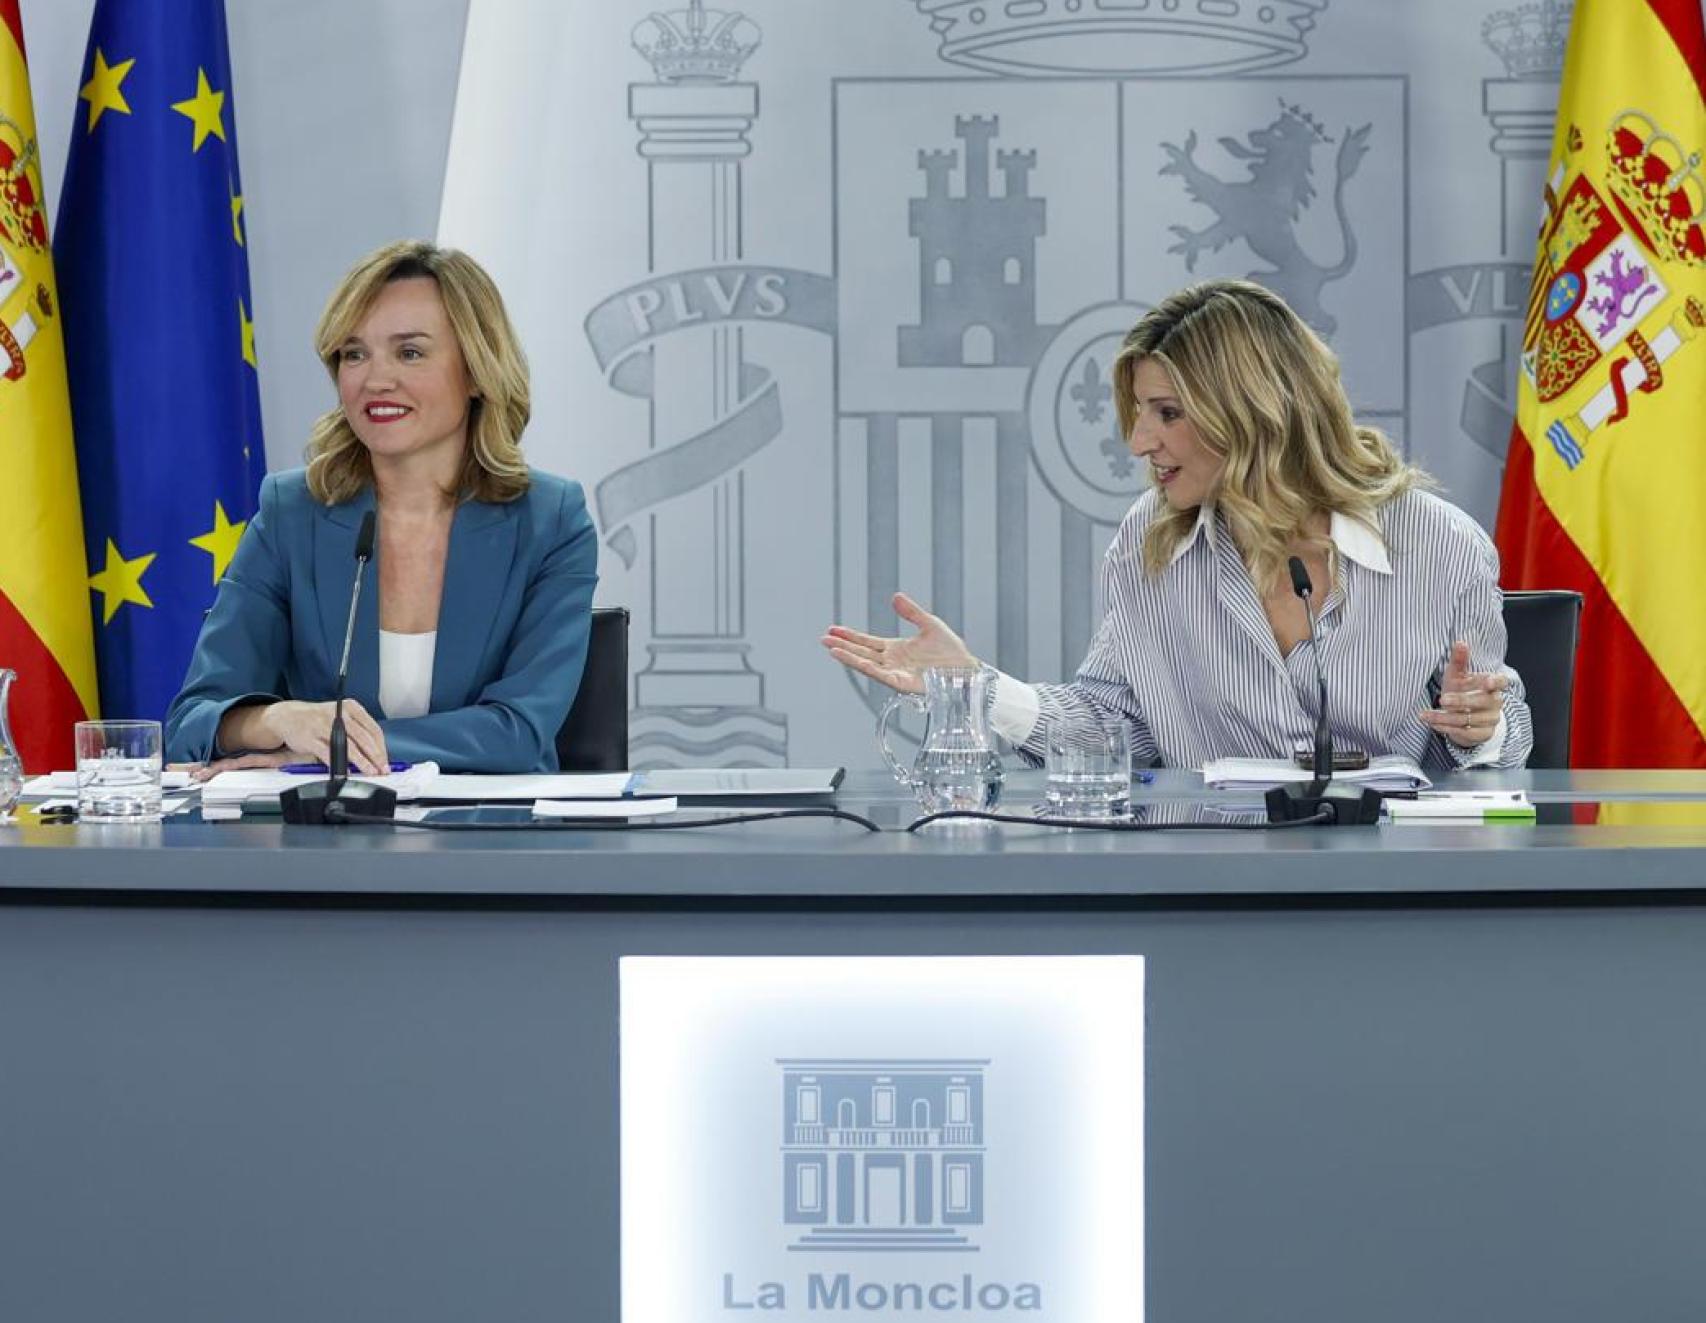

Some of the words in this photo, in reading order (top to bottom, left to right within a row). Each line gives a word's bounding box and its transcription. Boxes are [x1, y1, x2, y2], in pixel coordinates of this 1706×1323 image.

[626, 273, 787, 334] PLVS
[723, 1273, 785, 1310] La
[807, 1273, 1042, 1311] Moncloa
